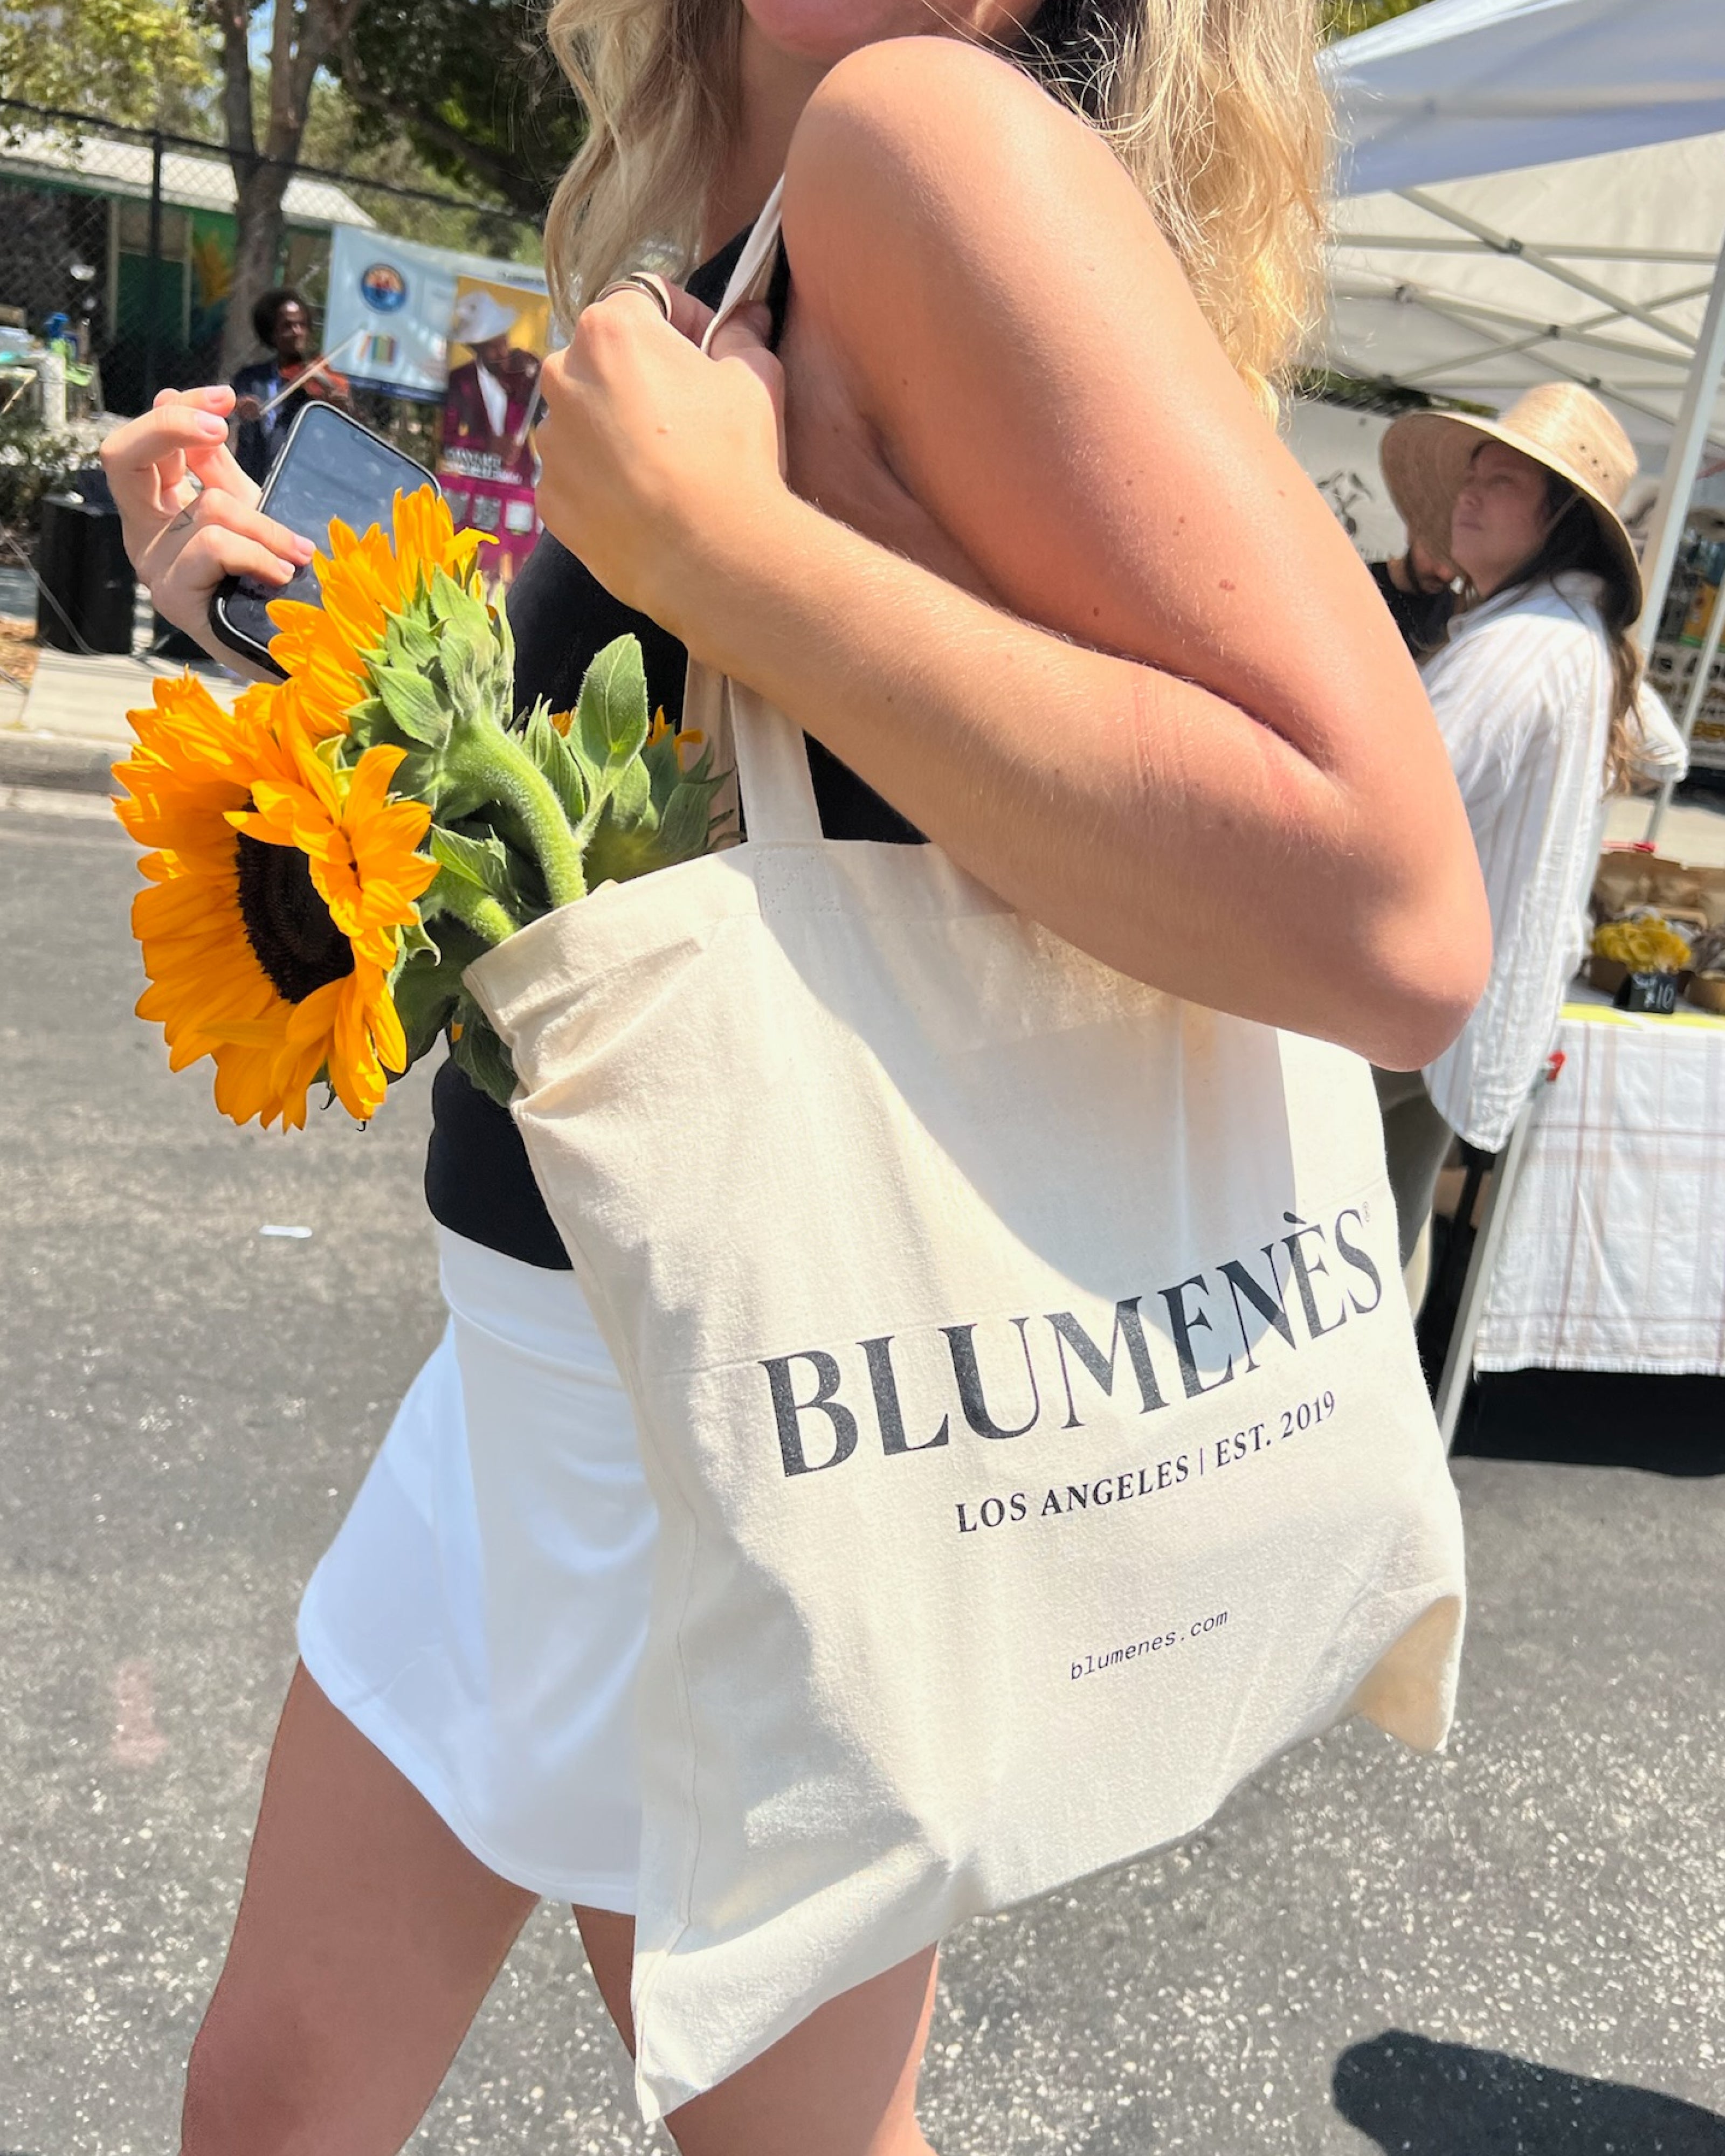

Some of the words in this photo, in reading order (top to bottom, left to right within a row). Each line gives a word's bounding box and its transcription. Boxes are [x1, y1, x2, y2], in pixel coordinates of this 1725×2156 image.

[757, 1209, 1383, 1477] BLUMENÈS
[955, 1492, 1027, 1533] LOS
[1040, 1455, 1190, 1517] ANGELES
[1215, 1423, 1272, 1468] EST.
[1279, 1390, 1336, 1440] 2019
[1071, 1609, 1229, 1681] blumenes.com
